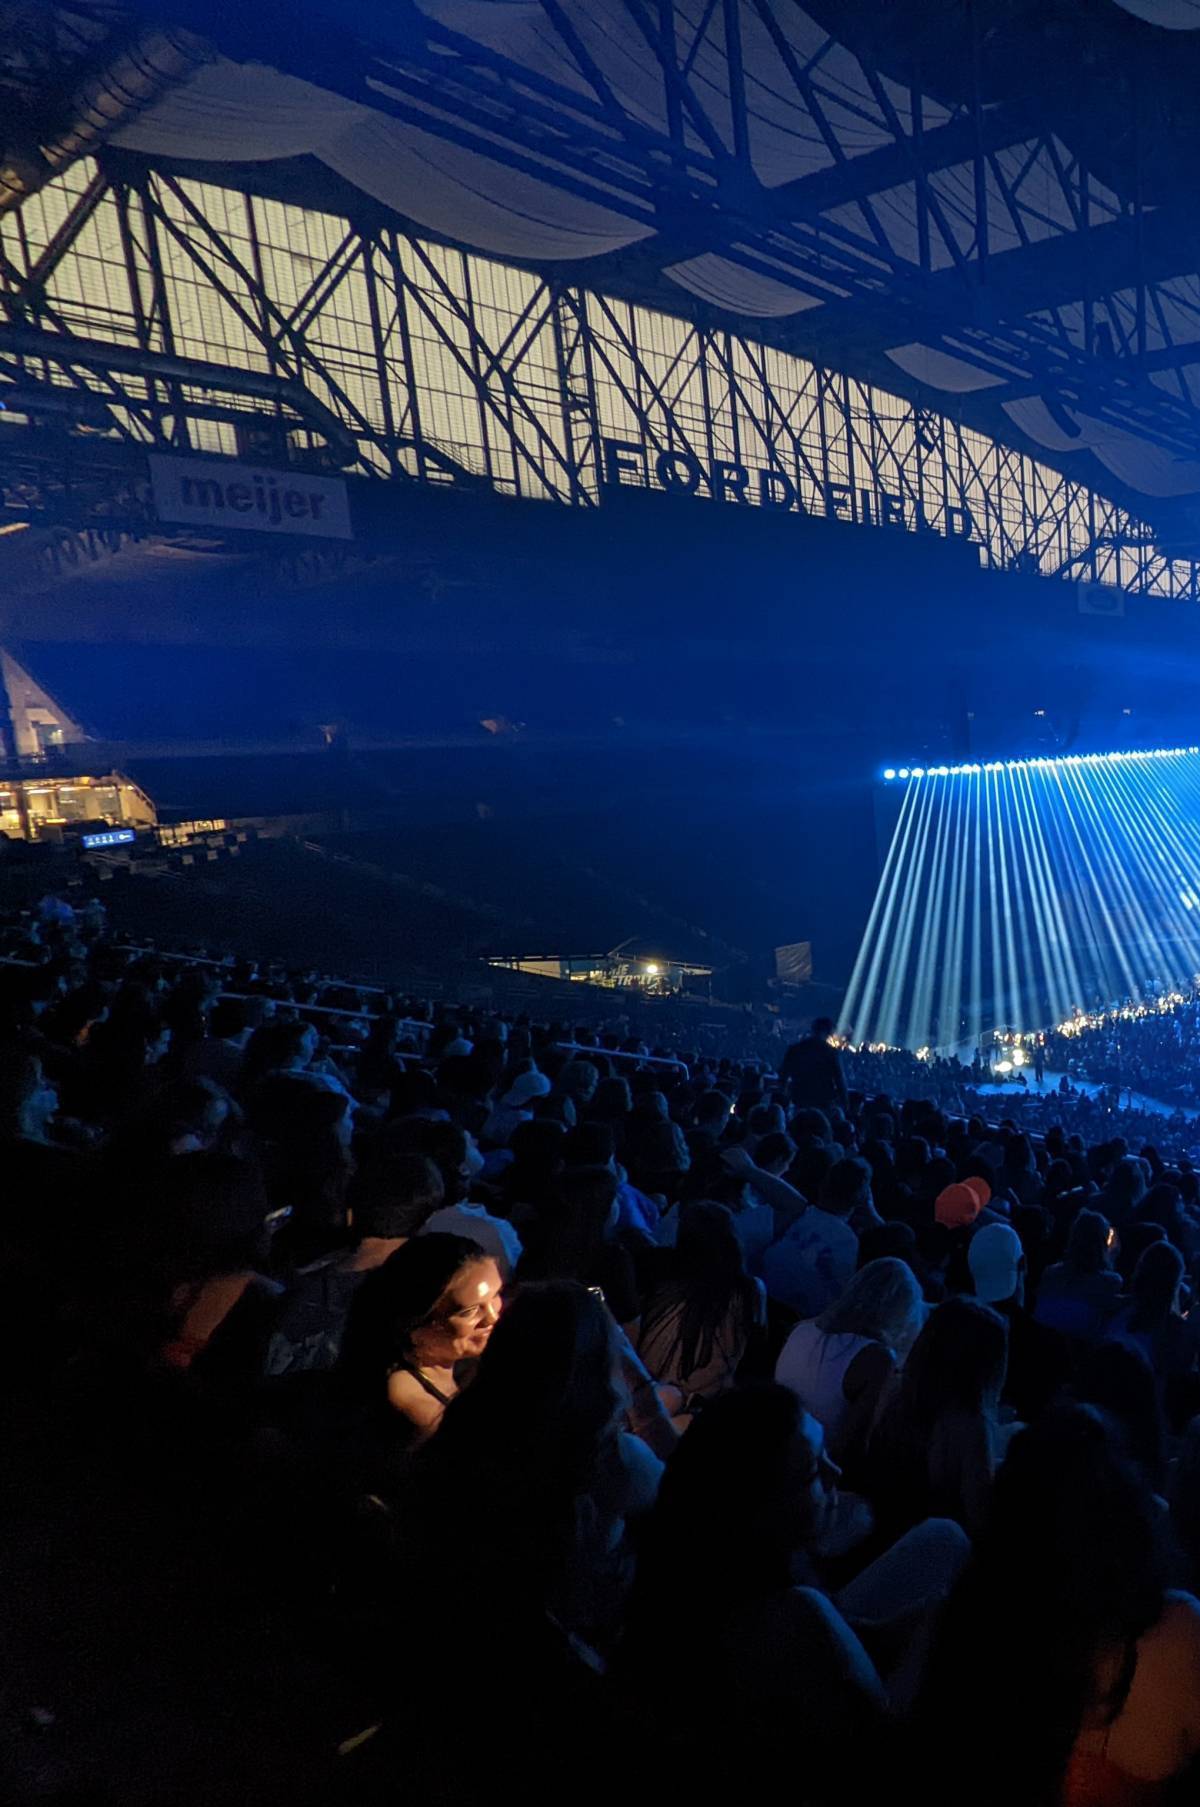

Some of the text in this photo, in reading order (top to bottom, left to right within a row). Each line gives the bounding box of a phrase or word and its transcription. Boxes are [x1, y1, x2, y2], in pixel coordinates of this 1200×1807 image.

[181, 476, 325, 524] meijer
[602, 438, 974, 543] FORD FIELD
